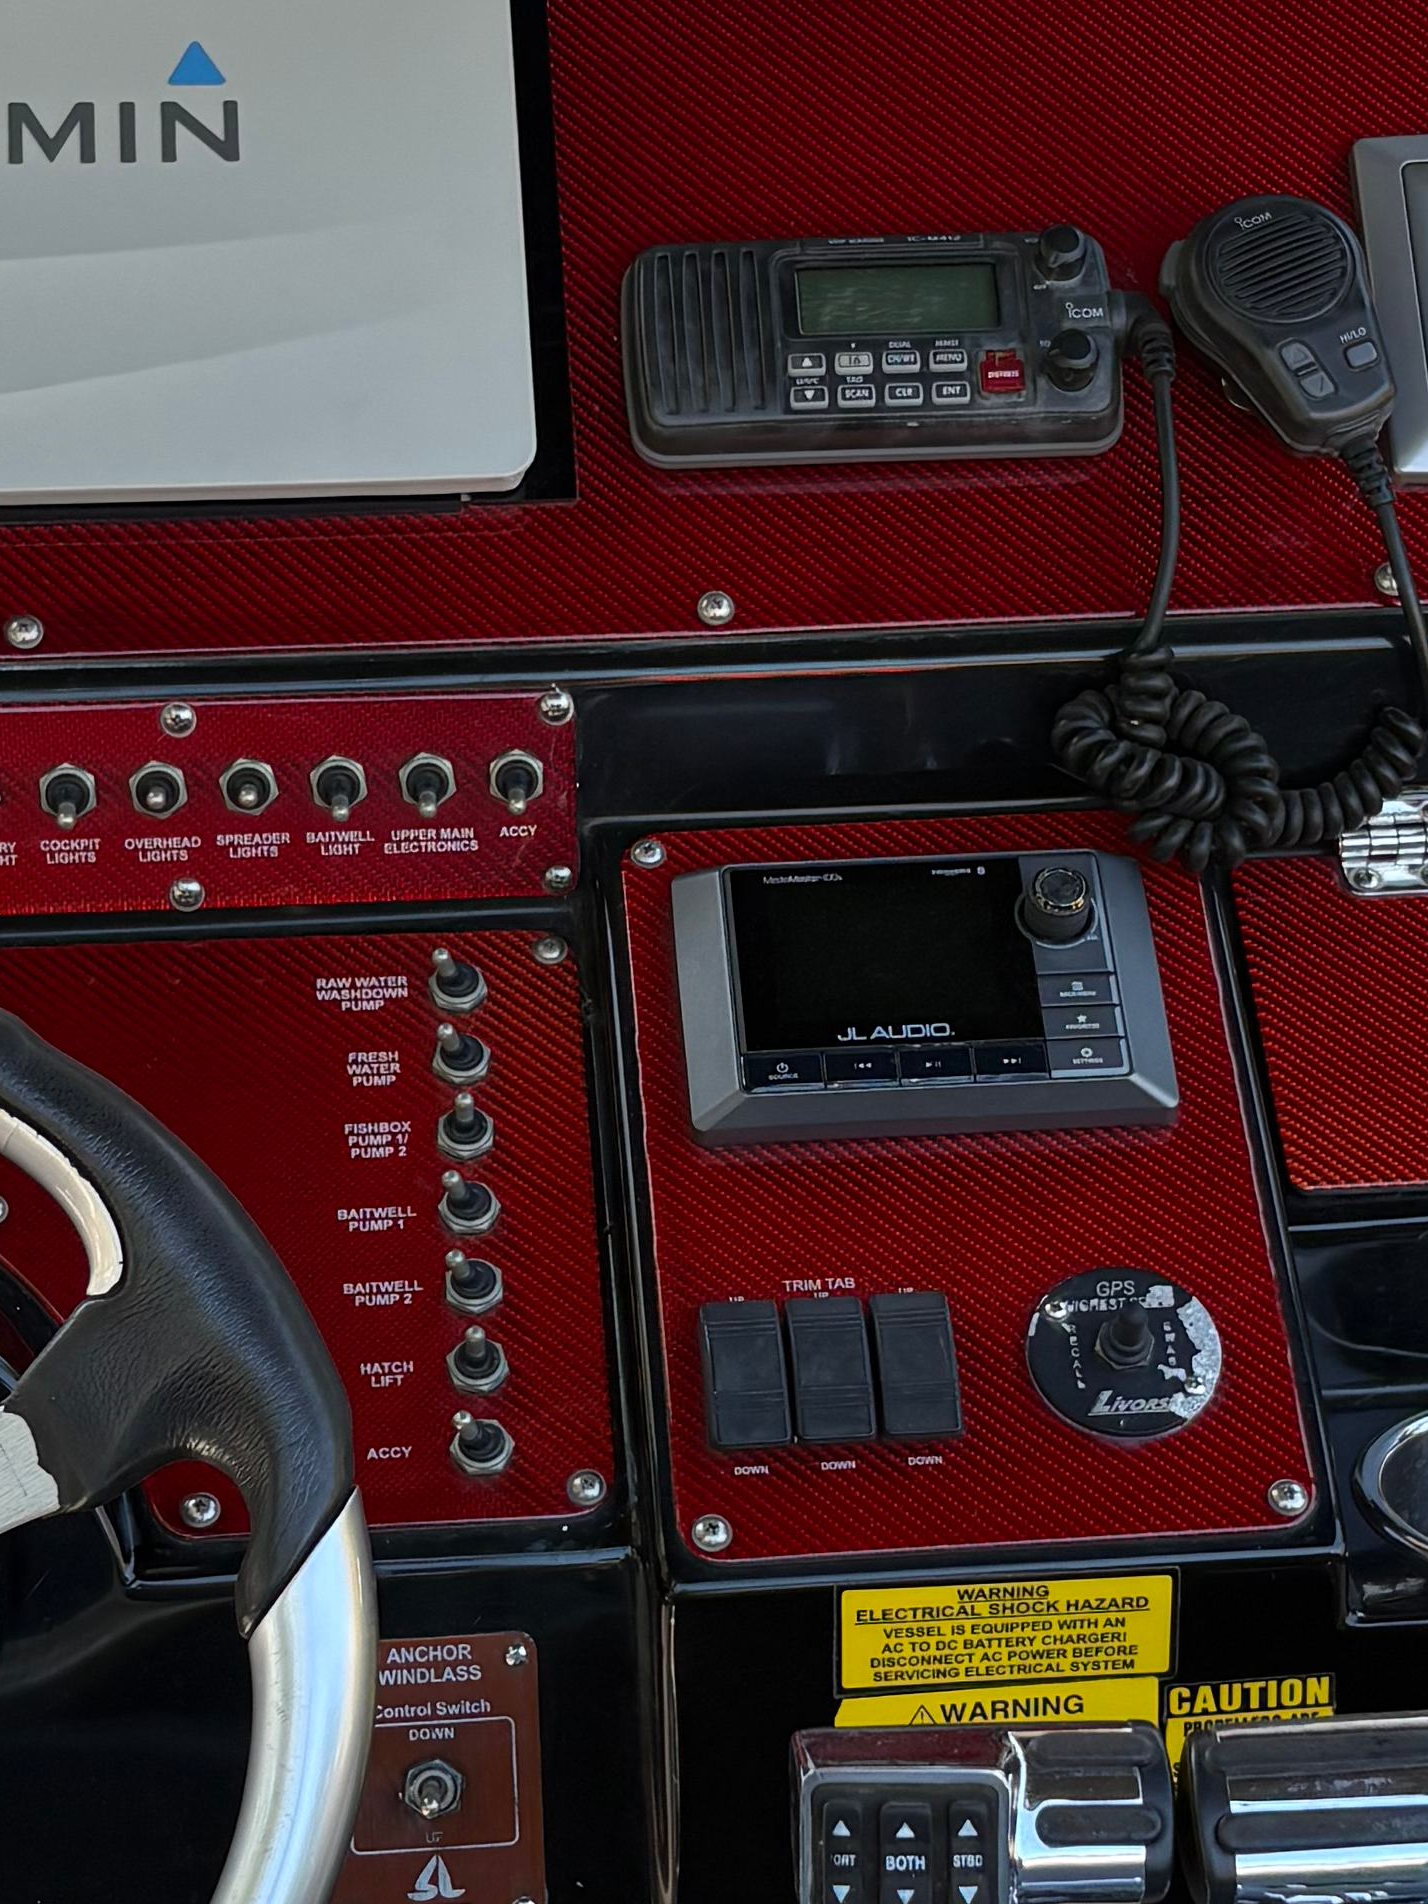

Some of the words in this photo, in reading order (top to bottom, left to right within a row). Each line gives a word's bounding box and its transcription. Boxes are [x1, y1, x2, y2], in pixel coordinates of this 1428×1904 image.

[306, 831, 375, 844] BAITWELL
[391, 829, 436, 841] UPPER
[440, 827, 474, 840] MAIN
[499, 825, 538, 837] ACCY
[40, 839, 101, 851] COCKPIT
[124, 836, 202, 850] OVERHEAD
[216, 832, 291, 846] SPREADER
[229, 846, 279, 859] LIGHTS
[320, 844, 361, 856] LIGHT
[384, 840, 479, 854] ELECTRONICS
[46, 852, 97, 865] LIGHTS
[138, 849, 189, 863] LIGHTS
[316, 977, 352, 989] RAW
[355, 976, 408, 987] WATER
[316, 987, 408, 1001] WASHDOWN
[341, 999, 385, 1012] PUMP
[838, 1027, 867, 1042] JL
[348, 1050, 399, 1063] FRESH
[346, 1062, 401, 1076] WATER
[352, 1074, 397, 1087] PUMP
[344, 1121, 412, 1135] FISHBOX
[348, 1134, 392, 1147] PUMP
[351, 1146, 394, 1159] PUMP
[398, 1145, 407, 1157] 2
[337, 1206, 417, 1221] BAITWELL
[348, 1219, 393, 1232] PUMP
[397, 1219, 404, 1230] 1
[343, 1280, 424, 1295] BAITWELL
[782, 1279, 822, 1292] TRIM
[824, 1277, 856, 1289] TAB
[1096, 1280, 1135, 1296] GPS
[355, 1293, 400, 1307] PUMP
[404, 1293, 413, 1304] 2
[360, 1361, 414, 1375] HATCH
[371, 1374, 405, 1388] LIFT
[367, 1446, 412, 1460] ACCY
[821, 1460, 856, 1471] DOWN
[908, 1456, 943, 1466] DOWN
[734, 1465, 769, 1475] DOWN
[957, 1585, 1050, 1601] WARNING
[856, 1605, 981, 1622] ELECTRICAL
[988, 1600, 1059, 1615] SHOCK
[1066, 1596, 1149, 1612] HAZARD
[883, 1626, 946, 1639] VESSEL
[951, 1624, 965, 1636] IS
[971, 1620, 1052, 1636] EQUIPPED
[1058, 1618, 1099, 1630] WITH
[1102, 1617, 1126, 1628] AN
[881, 1642, 904, 1654] AC
[908, 1641, 931, 1653] TO
[935, 1639, 959, 1651] DC
[963, 1636, 1037, 1650] BATTERY
[387, 1644, 472, 1664] ANCHOR
[870, 1654, 975, 1668] DISCONNECT
[980, 1651, 1003, 1663] AC
[1007, 1648, 1068, 1661] POWER
[1071, 1645, 1138, 1658] BEFORE
[379, 1665, 482, 1686] WINDLASS
[873, 1668, 960, 1682] SERVICING
[964, 1662, 1065, 1677] ELECTRICAL
[1069, 1658, 1135, 1671] SYSTEM
[1169, 1676, 1330, 1716] CAUTION
[436, 1699, 491, 1716] Switch
[940, 1695, 1084, 1723] WARNING
[409, 1728, 454, 1741] DOWN
[886, 1855, 926, 1871] BOTH
[952, 1854, 983, 1868] STBD
